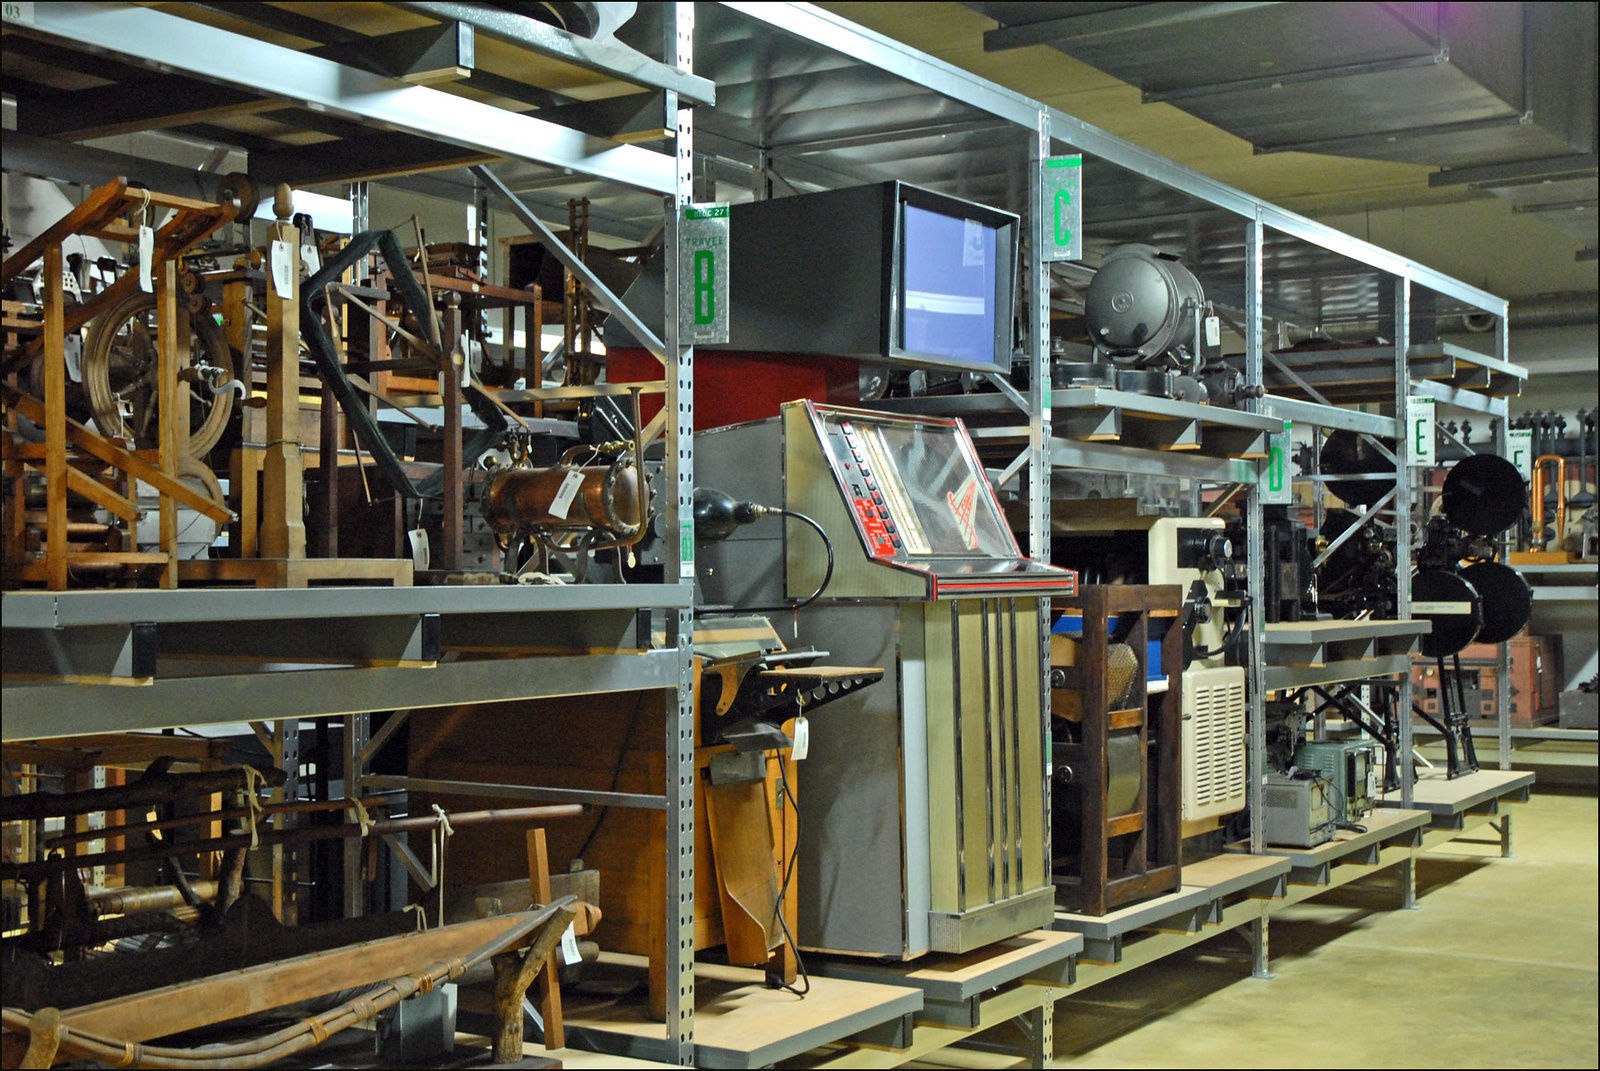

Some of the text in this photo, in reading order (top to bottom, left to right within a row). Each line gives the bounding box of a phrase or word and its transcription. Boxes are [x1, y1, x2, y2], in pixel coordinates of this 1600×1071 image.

[5, 4, 20, 18] 03
[714, 208, 725, 217] 27
[1054, 190, 1070, 246] C
[694, 249, 715, 325] B
[1415, 418, 1428, 456] E
[1269, 447, 1283, 492] D
